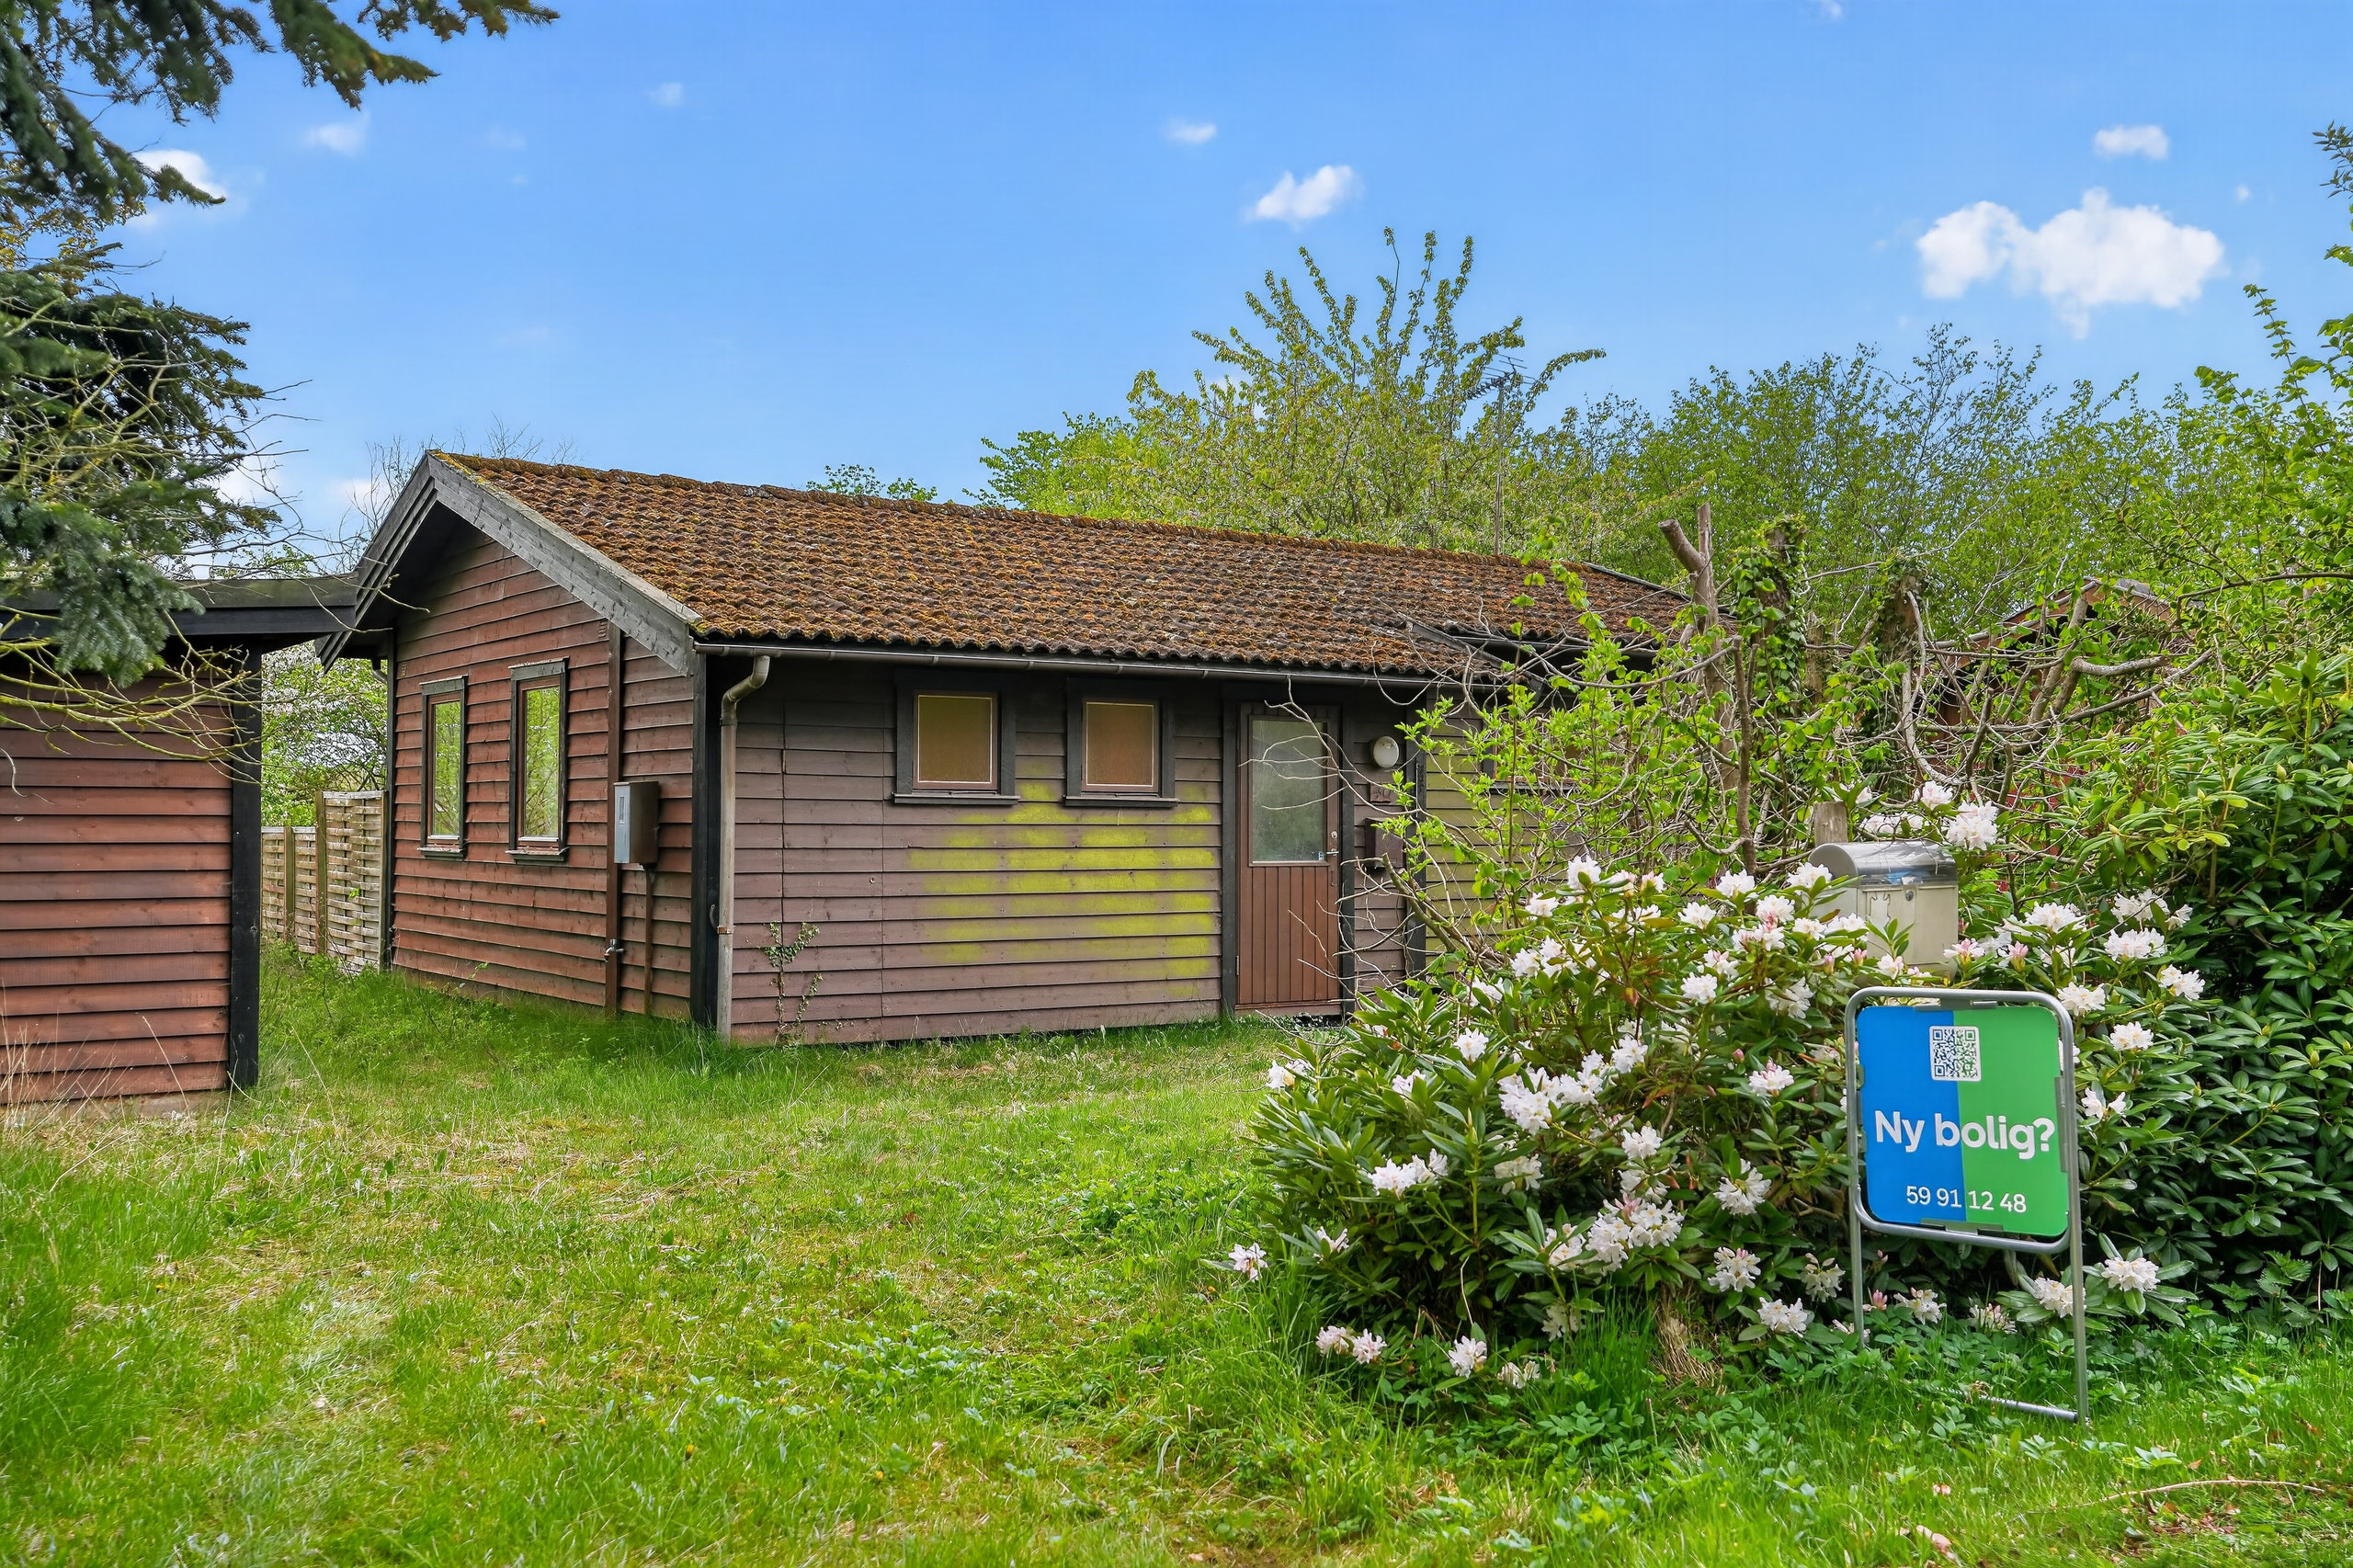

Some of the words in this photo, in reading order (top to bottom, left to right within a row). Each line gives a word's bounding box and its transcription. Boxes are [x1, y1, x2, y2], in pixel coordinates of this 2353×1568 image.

[1874, 1110, 1926, 1153] Ny
[1934, 1112, 2056, 1160] bolig?
[1905, 1186, 1931, 1205] 59
[1937, 1187, 1961, 1208] 91
[1969, 1190, 1994, 1210] 12
[1999, 1193, 2027, 1213] 48
